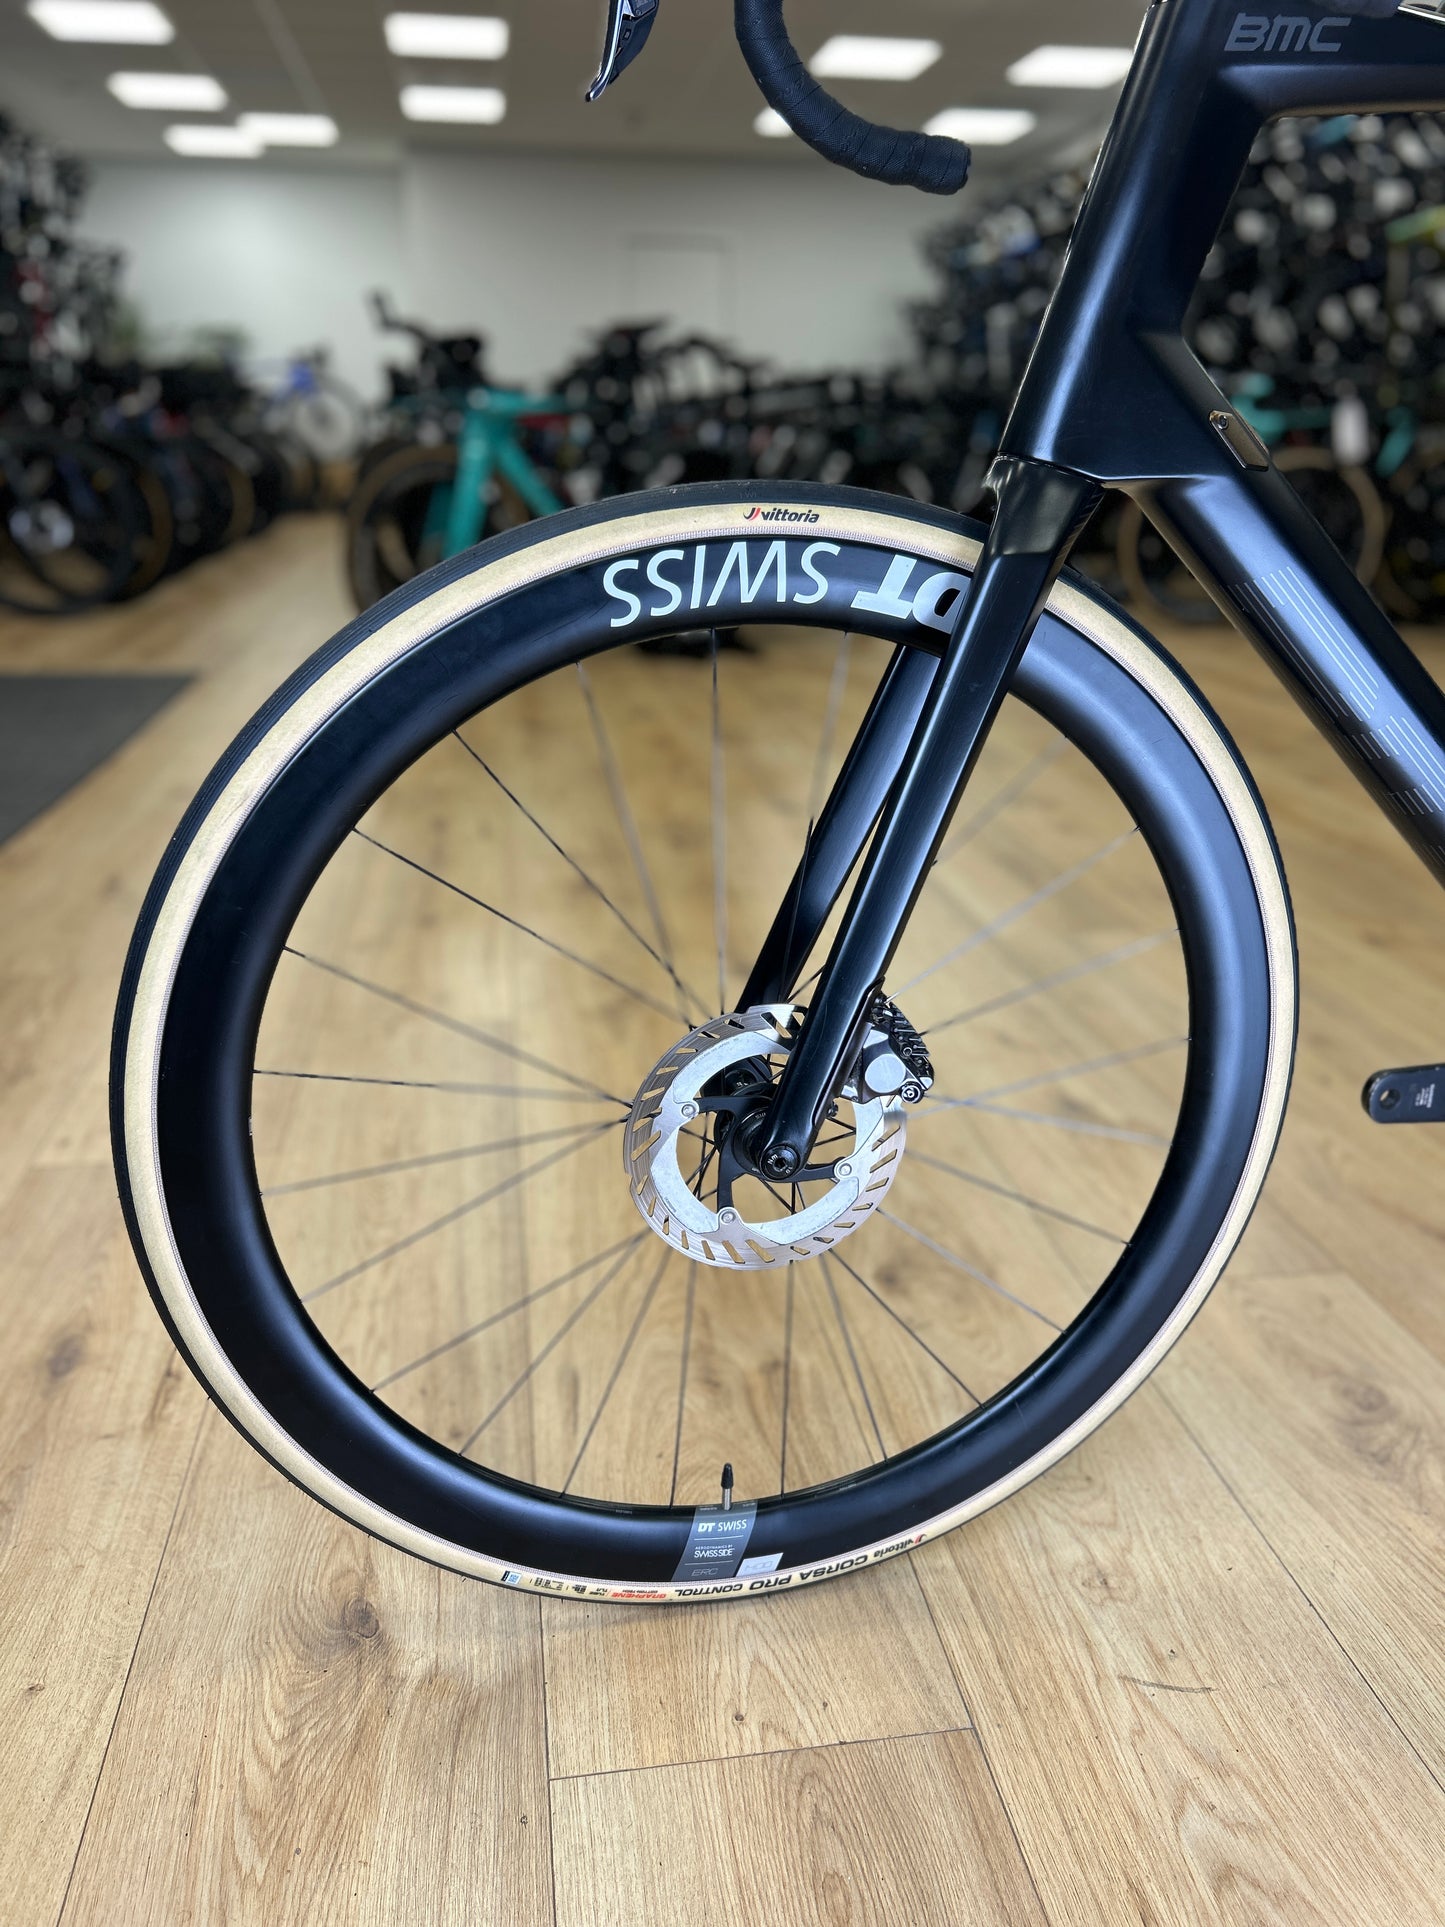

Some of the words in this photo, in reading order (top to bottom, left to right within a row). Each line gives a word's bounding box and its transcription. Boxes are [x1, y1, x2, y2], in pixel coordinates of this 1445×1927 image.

[1224, 12, 1352, 52] BMC
[761, 507, 820, 523] vittoria
[602, 540, 842, 628] SWISS
[850, 554, 972, 635] DT
[698, 1522, 715, 1533] DT
[717, 1519, 748, 1532] SWISS
[873, 1538, 914, 1558] vittoria
[691, 1568, 718, 1577] ERC
[800, 1554, 868, 1581] CORSA
[674, 1583, 743, 1597] CONTROL
[749, 1574, 792, 1591] PRO
[611, 1592, 666, 1600] GRAPHENE
